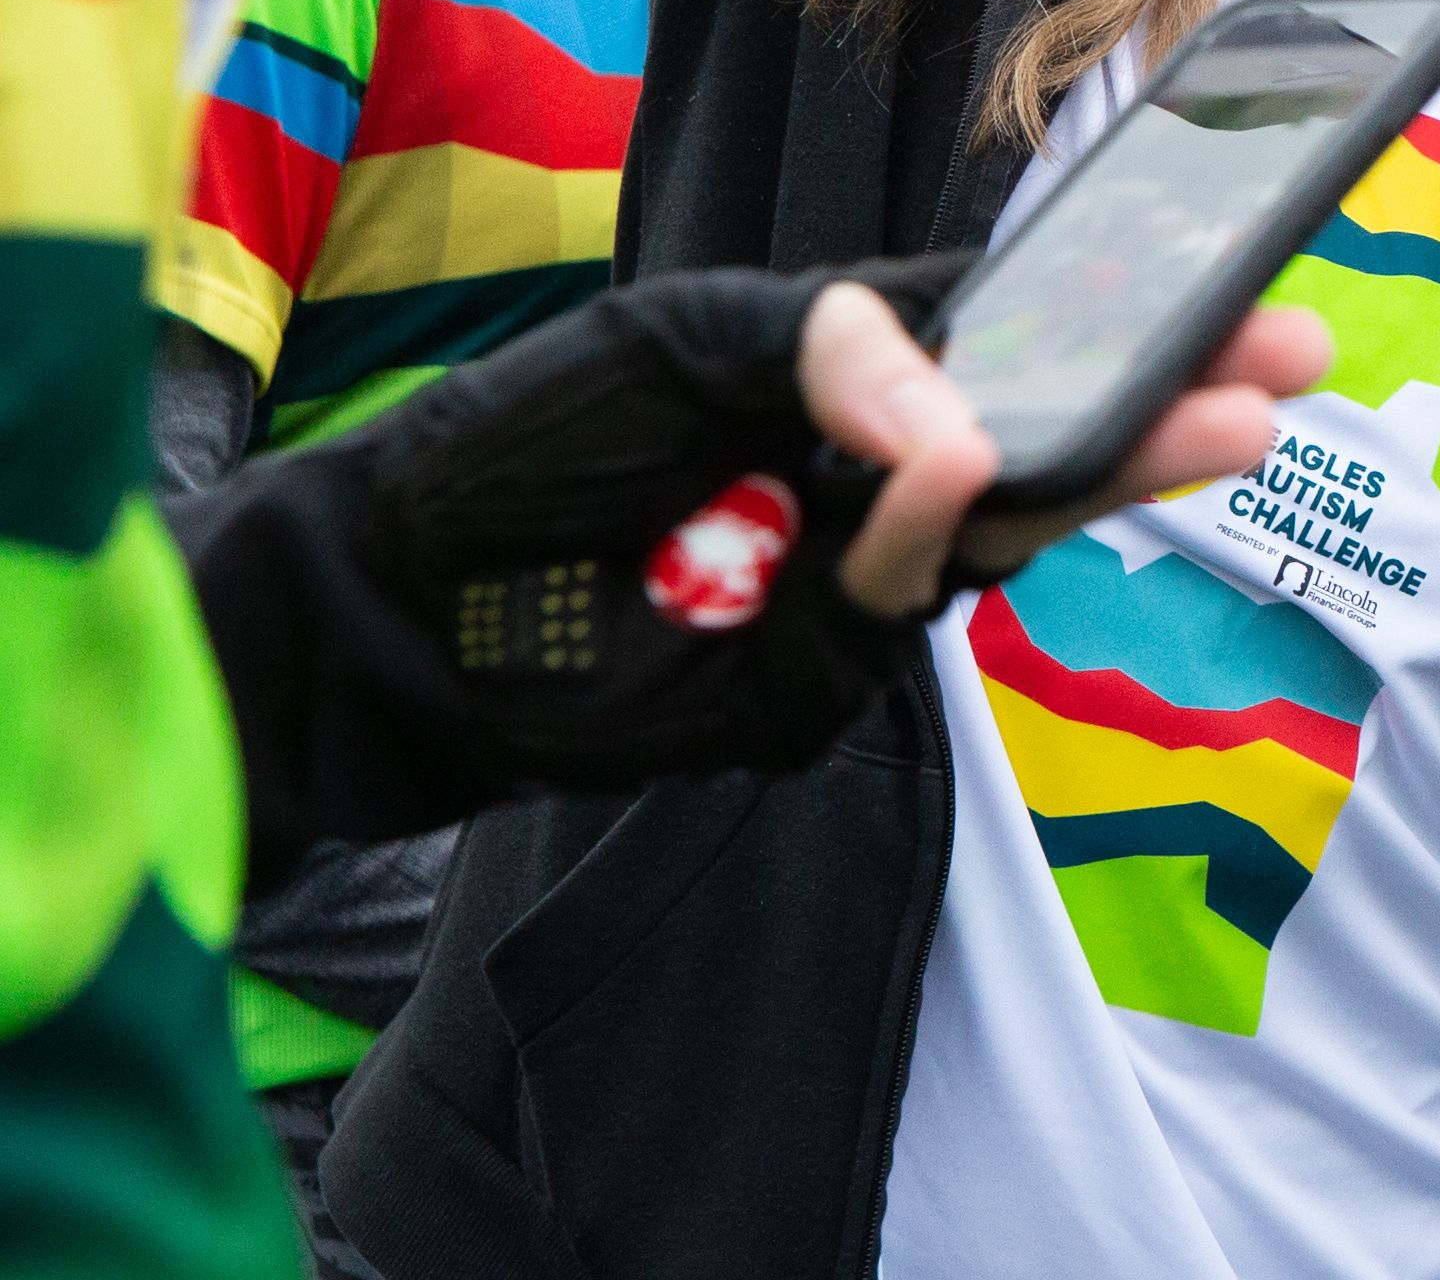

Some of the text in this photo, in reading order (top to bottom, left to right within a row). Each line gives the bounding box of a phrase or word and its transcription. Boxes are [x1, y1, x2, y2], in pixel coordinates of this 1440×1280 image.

[1241, 458, 1375, 534] AUTISM
[1215, 522, 1280, 557] PRESENTED BY
[1228, 488, 1428, 597] CHALLENGE
[1306, 590, 1346, 616] Financial
[1312, 567, 1379, 615] Lincoln
